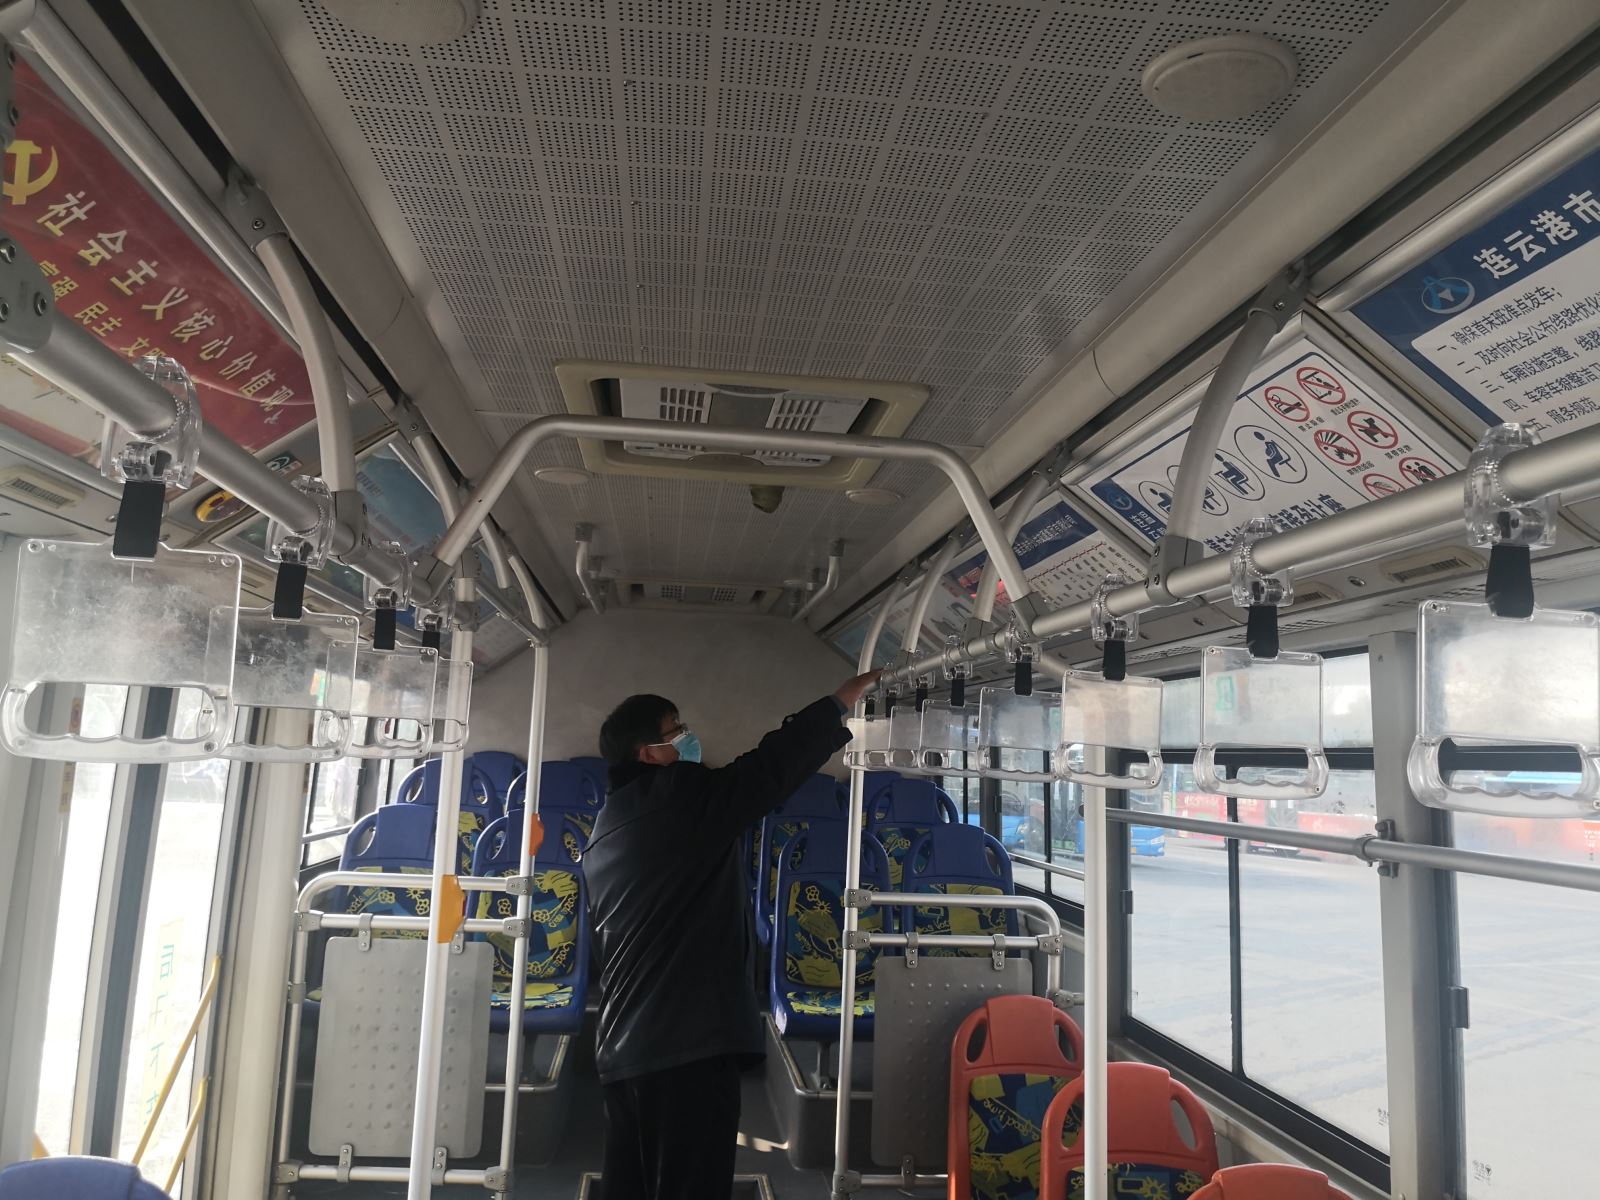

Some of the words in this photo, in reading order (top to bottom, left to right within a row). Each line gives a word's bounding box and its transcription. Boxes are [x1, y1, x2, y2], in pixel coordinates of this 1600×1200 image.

[1473, 190, 1600, 279] 连云港市
[37, 191, 294, 414] 社会主义核心价值观
[74, 301, 122, 337] 民主
[1457, 291, 1600, 374] 二、及时向社会公布线路优化
[1480, 327, 1600, 393] 三、车厢设施完整，线路
